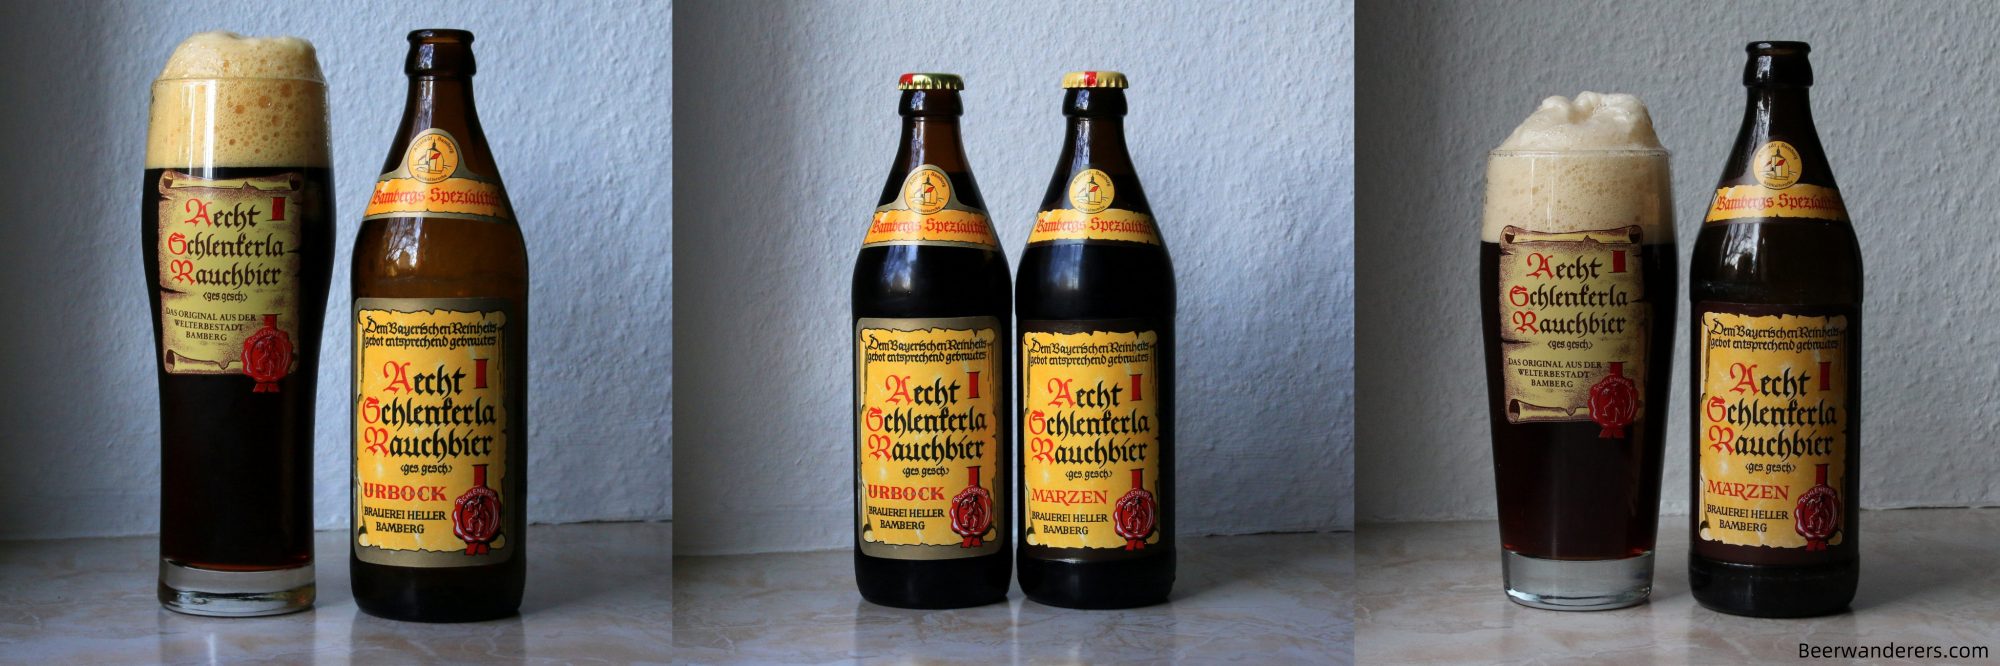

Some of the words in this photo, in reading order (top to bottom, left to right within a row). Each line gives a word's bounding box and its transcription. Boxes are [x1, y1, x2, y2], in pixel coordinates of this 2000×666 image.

[184, 198, 261, 229] Aecht
[168, 232, 285, 260] Schlenkerla
[170, 259, 282, 290] Rauchbier
[1526, 252, 1603, 282] Aecht
[1509, 284, 1629, 311] Schlenkerla
[166, 307, 179, 317] DAS
[178, 309, 218, 322] ORIGINAL
[220, 312, 237, 322] AUS
[238, 313, 257, 322] DER
[1512, 310, 1626, 338] Rauchbier
[174, 320, 244, 332] WELTERBESTADT
[365, 316, 388, 335] Dem
[389, 321, 451, 338] Bayerischen
[1711, 318, 1735, 336] Dem
[1736, 325, 1800, 340] Bayerischen
[185, 331, 228, 342] BAMBERG
[365, 335, 384, 349] gebot
[385, 335, 449, 350] entsprechend
[450, 335, 497, 350] gebrautes
[868, 334, 889, 351] Dem
[890, 340, 947, 354] Bayerischen
[1710, 337, 1731, 350] gebot
[1733, 338, 1795, 353] entsprechend
[1031, 338, 1051, 354] Dem
[1052, 343, 1109, 356] Bayerischen
[868, 351, 886, 364] gebot
[887, 351, 945, 366] entsprechend
[1030, 354, 1048, 367] gebot
[1049, 354, 1107, 368] entsprechend
[1508, 357, 1522, 366] DAS
[1522, 359, 1564, 369] ORIGINAL
[1565, 361, 1582, 369] AUS
[1584, 361, 1602, 369] DER
[383, 360, 467, 400] Aecht
[1518, 369, 1590, 379] WELTERBESTADT
[1531, 379, 1574, 388] BAMBERG
[1729, 362, 1811, 401] Aecht
[885, 374, 961, 409] Aecht
[1047, 377, 1123, 411] Aecht
[362, 396, 497, 431] Schlenkerla
[866, 405, 987, 438] Schlenkerla
[1707, 395, 1837, 430] Schlenkerla
[1029, 408, 1150, 441] Schlenkerla
[364, 426, 493, 463] Rauchbier
[868, 434, 985, 467] Rauchbier
[1031, 437, 1148, 469] Rauchbier
[1709, 425, 1834, 462] Rauchbier
[363, 483, 447, 502] URBOCK
[868, 484, 945, 501] URBOCK
[1031, 487, 1108, 506] MÄRZEN
[1707, 479, 1790, 501] MÄRZEN
[364, 506, 406, 520] BRAUEREI
[407, 508, 447, 521] HELLER
[868, 505, 908, 518] BRAUEREI
[909, 506, 945, 518] HELLER
[1031, 510, 1071, 523] BRAUEREI
[1072, 511, 1109, 523] HELLER
[1707, 504, 1749, 518] BRAUEREI
[1751, 506, 1790, 520] HELLER
[375, 520, 425, 534] BAMBERG
[880, 519, 926, 531] BAMBERG
[1043, 523, 1089, 535] BAMBERG
[1719, 519, 1768, 533] BAMBERG
